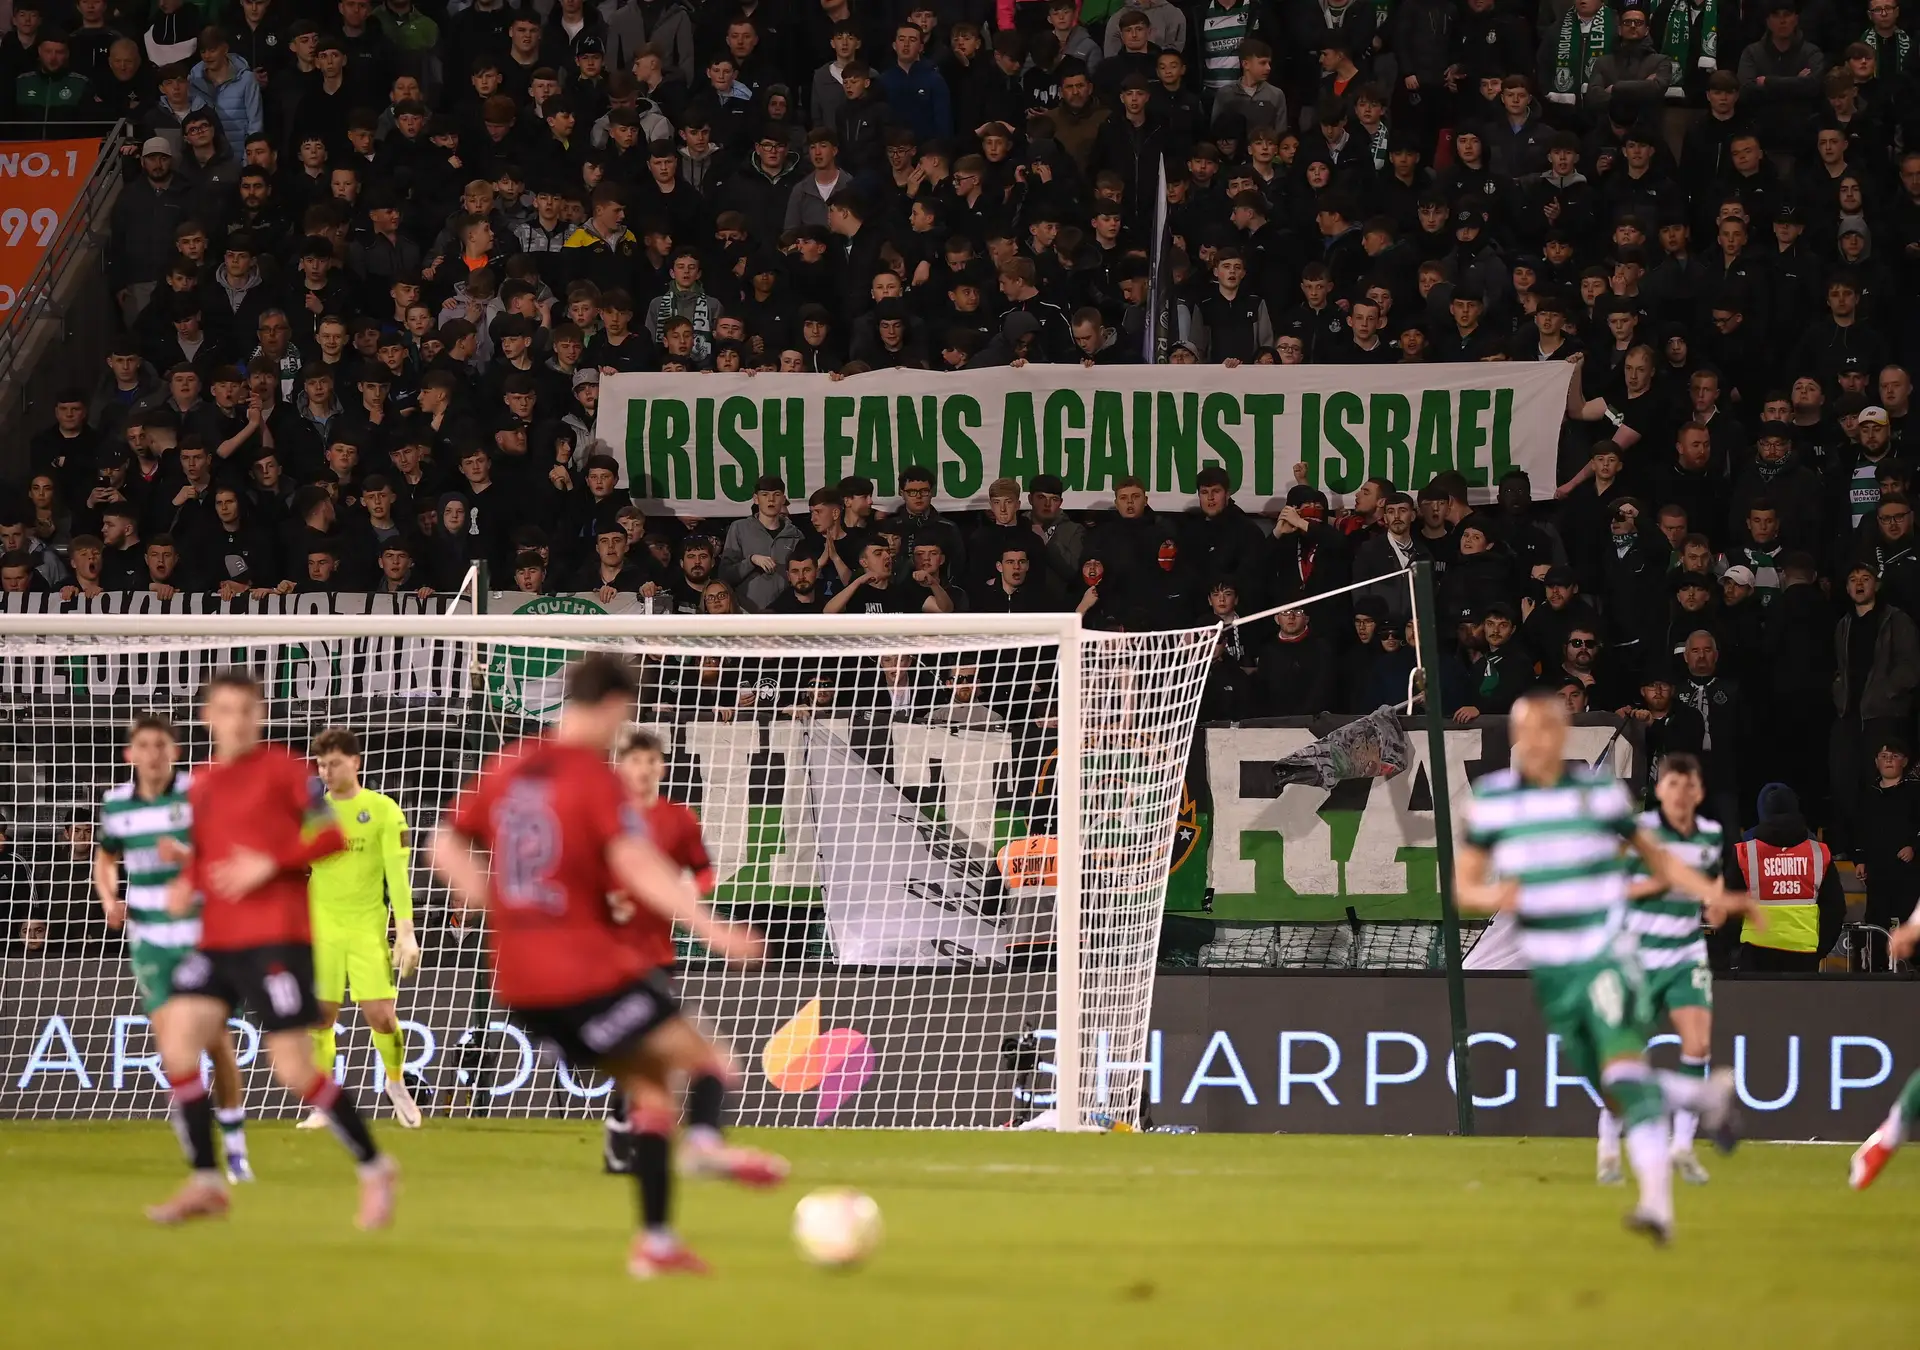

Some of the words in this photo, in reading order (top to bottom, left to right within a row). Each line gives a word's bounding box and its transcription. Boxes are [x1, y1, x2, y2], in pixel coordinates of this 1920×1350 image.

[625, 397, 805, 501] IRISH
[824, 395, 982, 499] FANS
[1001, 389, 1285, 496] AGAINST
[1300, 388, 1520, 493] ISRAEL
[865, 602, 884, 614] ANTI
[1763, 856, 1808, 877] SECURITY
[1772, 880, 1801, 895] 2835
[1013, 1028, 1894, 1110] SHARPGRUP
